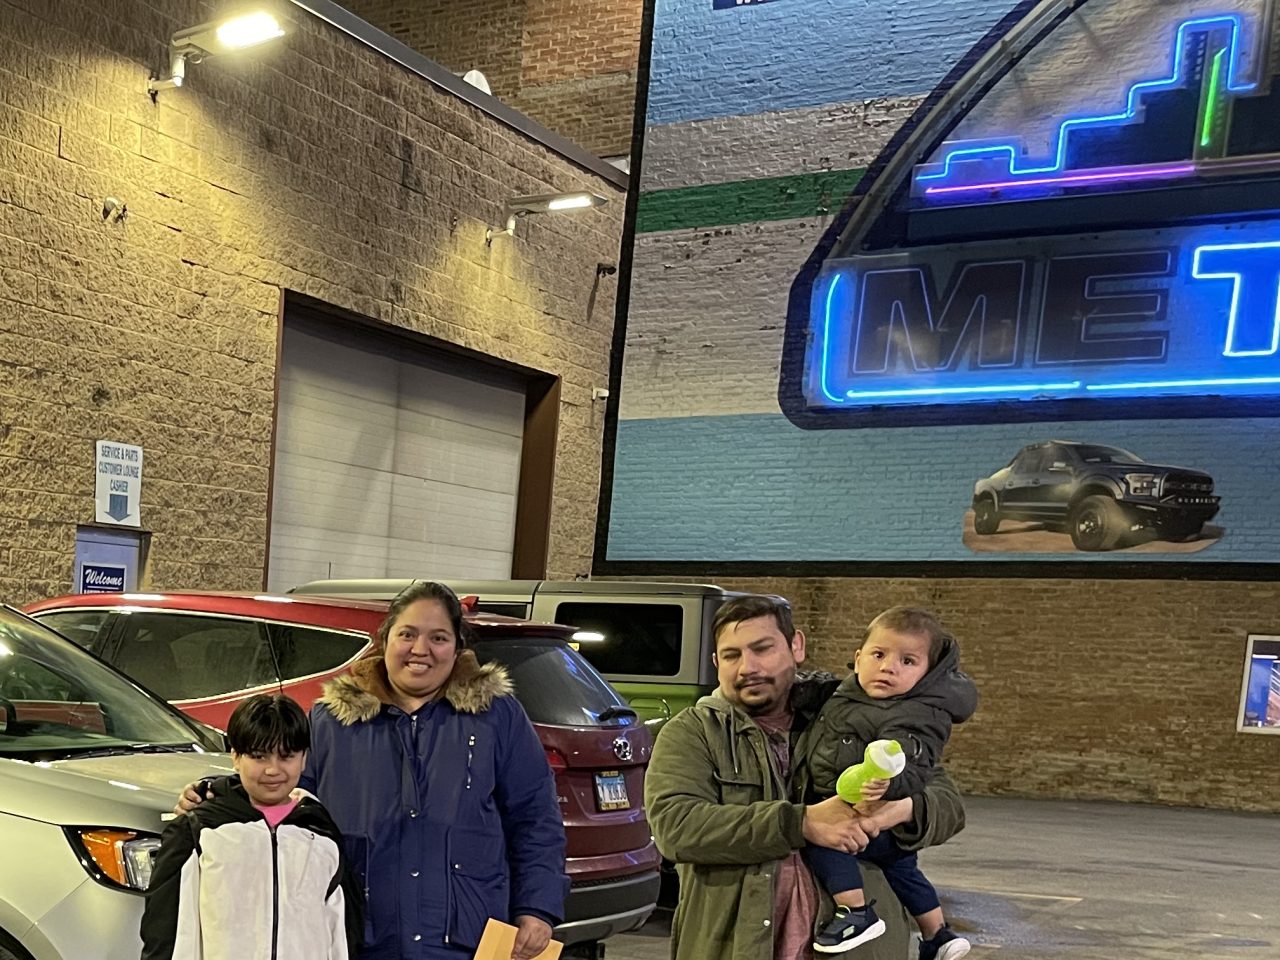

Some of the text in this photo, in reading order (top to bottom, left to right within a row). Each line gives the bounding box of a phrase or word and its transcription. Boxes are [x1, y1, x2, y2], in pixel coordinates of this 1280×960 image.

[101, 445, 120, 460] SERVICE
[126, 449, 139, 462] PARTS
[99, 461, 139, 479] CUSTOMER LOUNGE
[85, 569, 123, 586] Welcome
